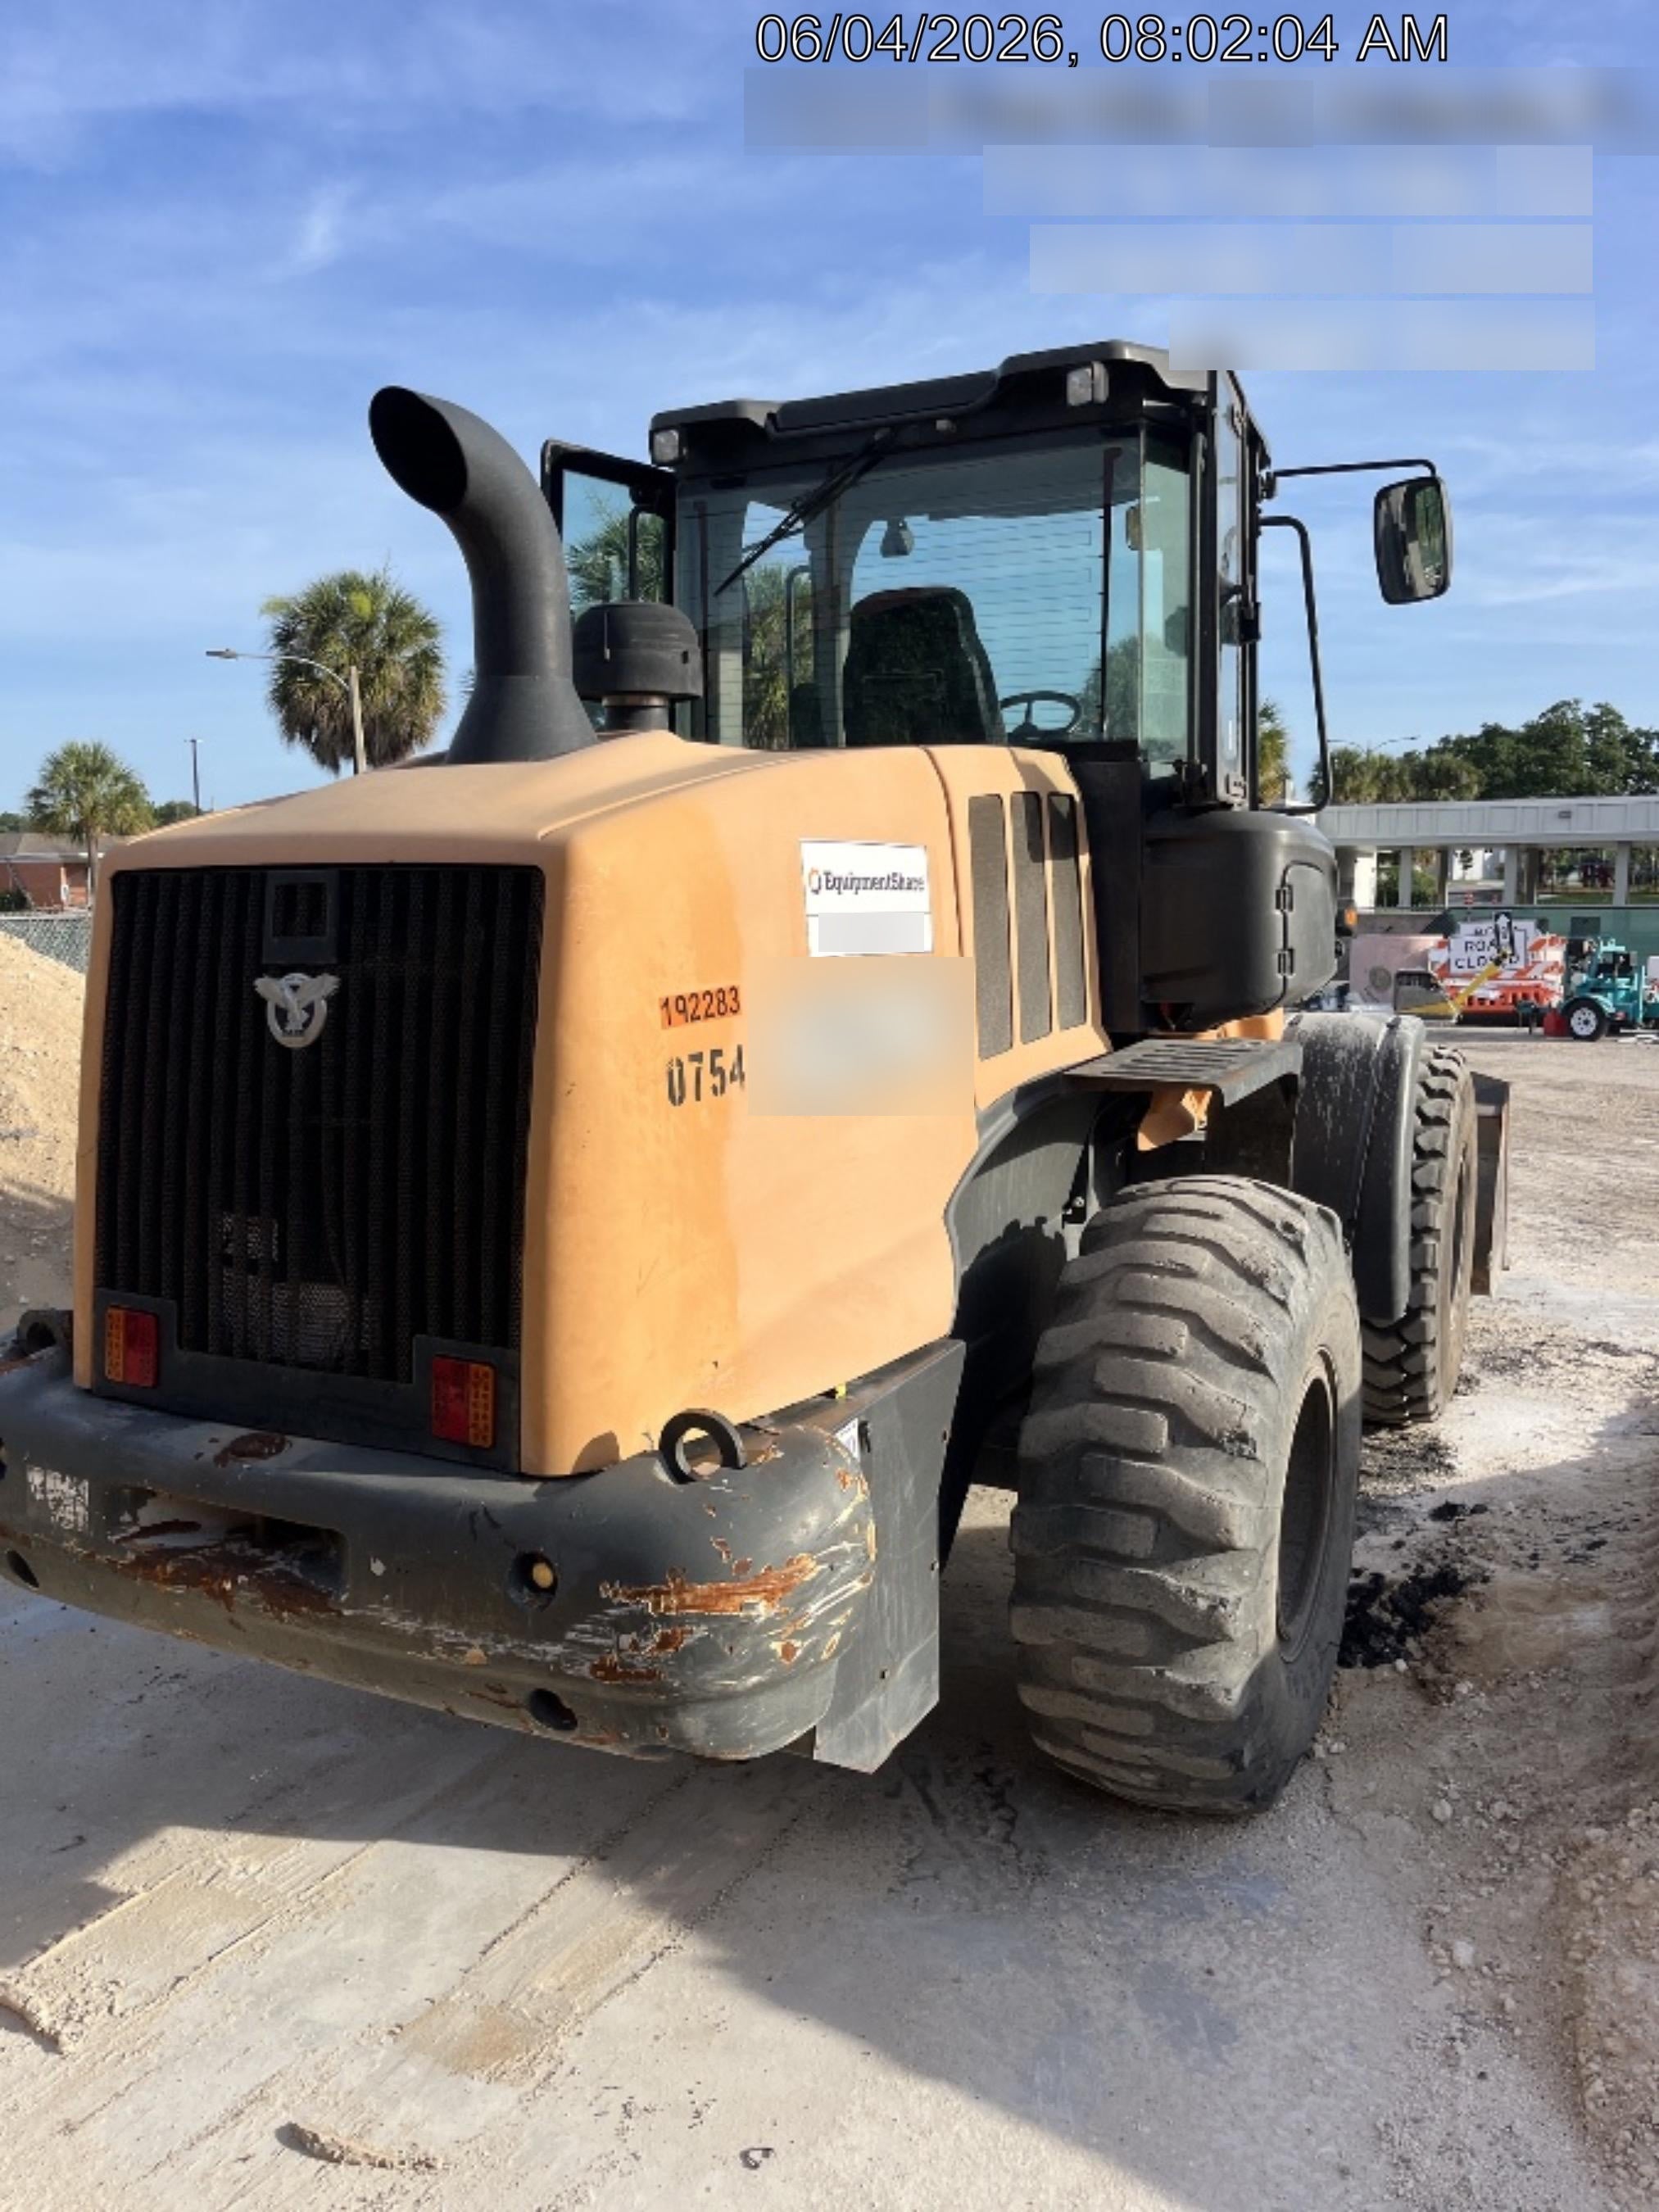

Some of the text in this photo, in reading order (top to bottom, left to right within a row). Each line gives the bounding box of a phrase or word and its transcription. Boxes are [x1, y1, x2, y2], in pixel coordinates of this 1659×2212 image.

[823, 870, 924, 895] EquipmentShare
[660, 985, 741, 1026] 192283
[667, 1044, 746, 1107] 0754
